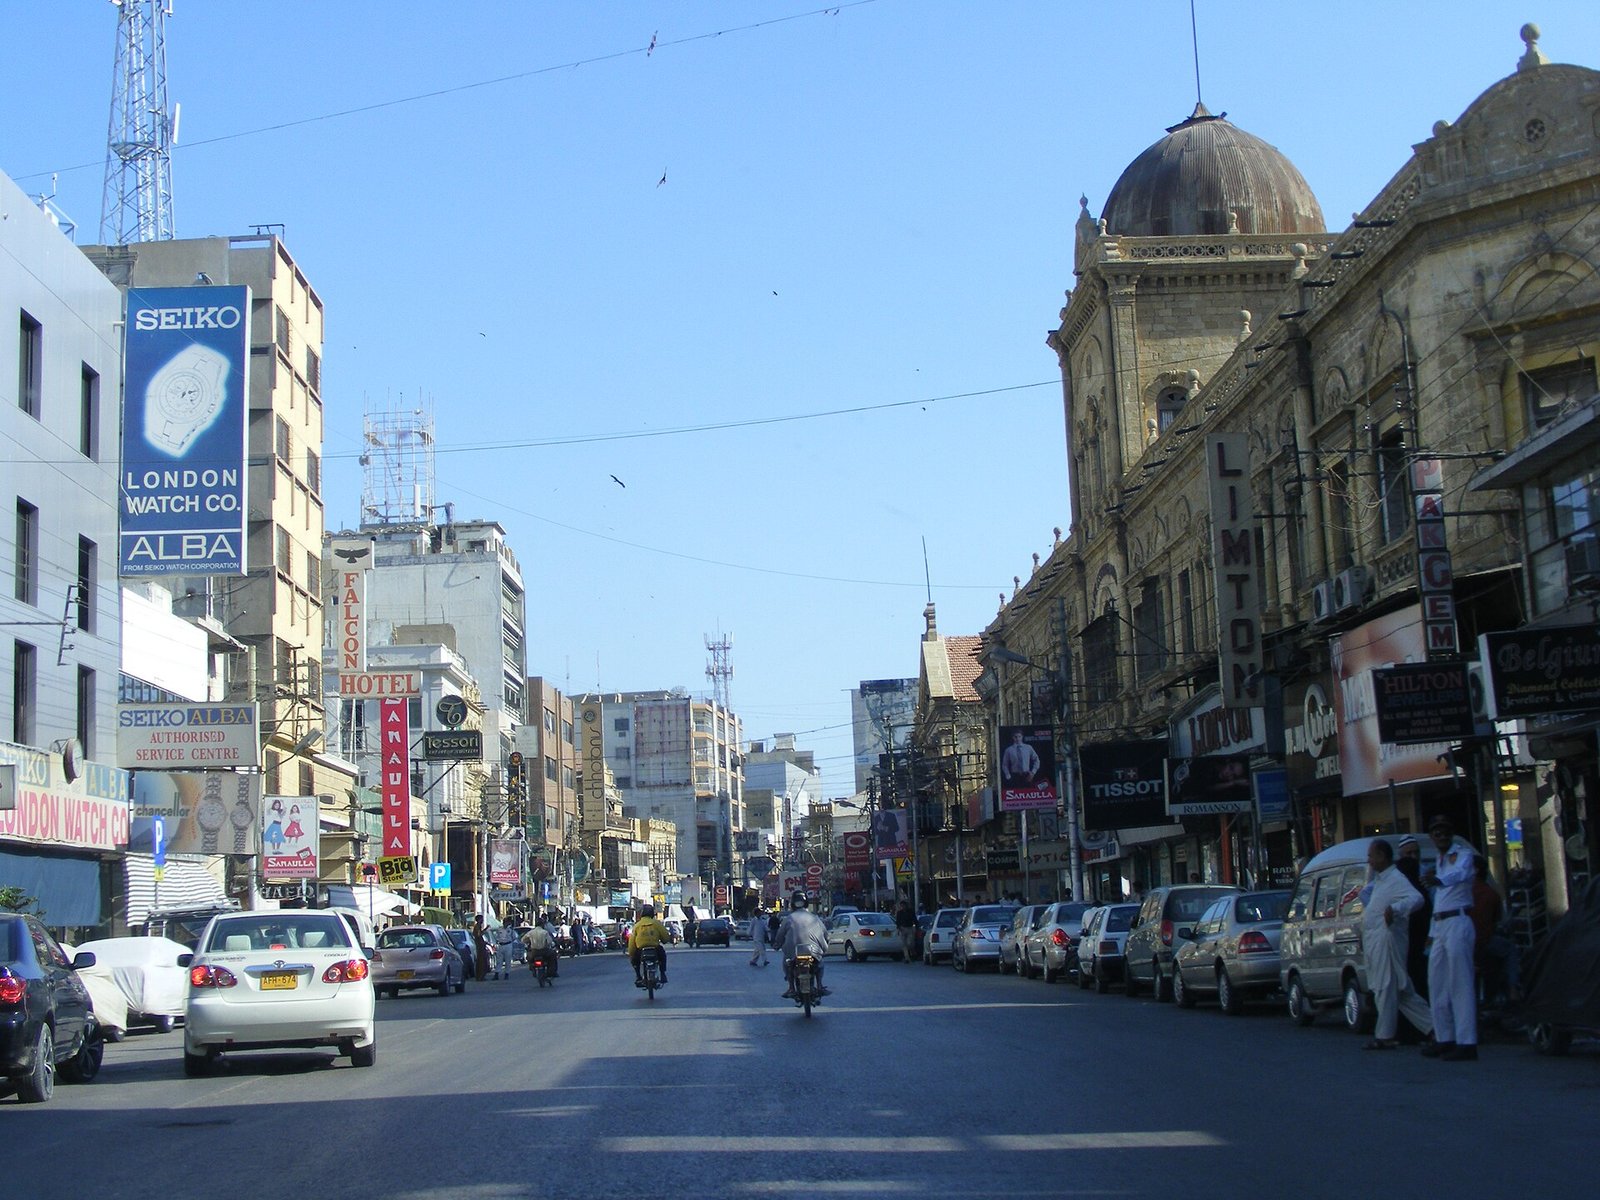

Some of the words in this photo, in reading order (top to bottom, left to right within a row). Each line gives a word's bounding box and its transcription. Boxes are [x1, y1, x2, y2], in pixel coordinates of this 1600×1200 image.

[136, 306, 241, 331] SEIKO
[127, 469, 238, 490] LONDON
[126, 494, 200, 515] WATCH
[205, 493, 241, 512] CO.
[127, 534, 236, 561] ALBA
[123, 564, 143, 572] FROM
[166, 563, 190, 571] WATCH
[190, 561, 240, 571] CORPORATION
[1217, 442, 1258, 700] LIMTON
[343, 572, 360, 669] FALCON
[339, 673, 420, 695] HOTEL
[1384, 671, 1465, 694] HILTON
[119, 709, 186, 728] SEIKO
[188, 706, 252, 725] ALBA
[150, 731, 226, 744] AUTHORISED
[426, 734, 479, 750] Tessori
[136, 748, 185, 761] SERVICE
[191, 747, 240, 760] CENTRE
[88, 765, 128, 802] ALBA
[1090, 778, 1163, 798] TISSOT
[136, 791, 190, 817] chancellor
[1183, 803, 1242, 814] ROMANSON
[63, 796, 108, 846] WATCH
[155, 820, 163, 854] P
[267, 857, 315, 868] SANAULLA
[434, 865, 446, 884] P
